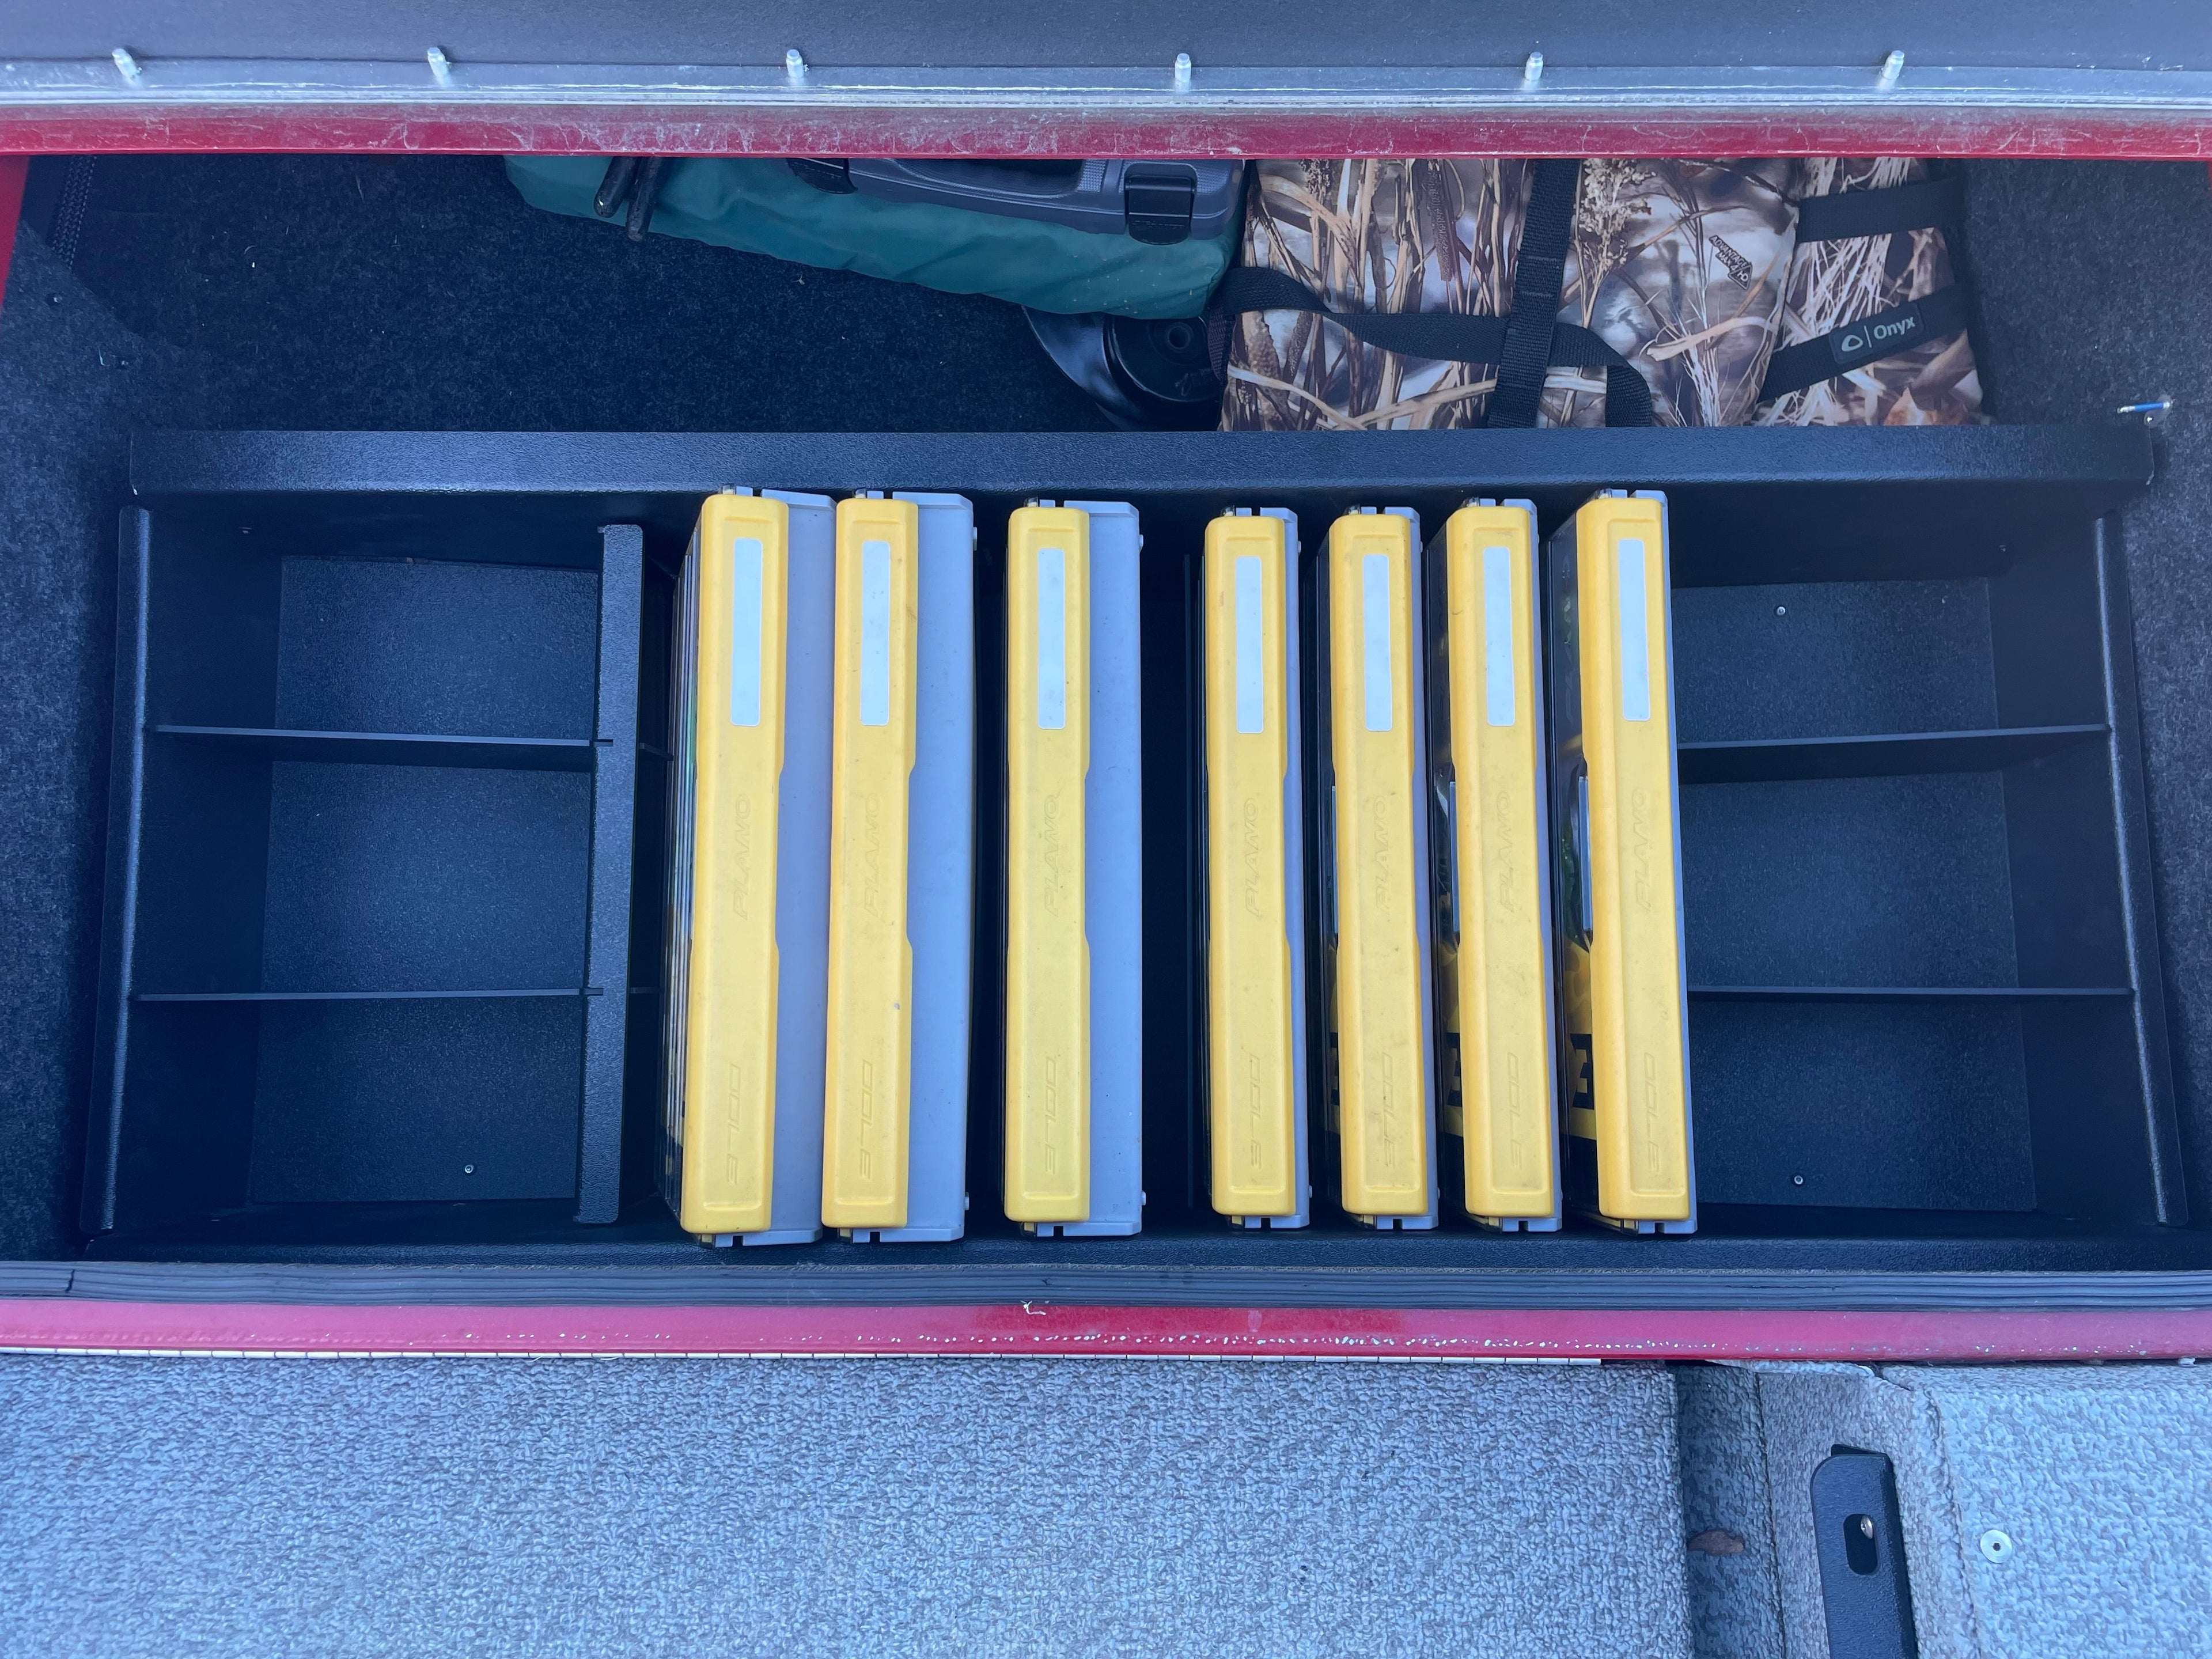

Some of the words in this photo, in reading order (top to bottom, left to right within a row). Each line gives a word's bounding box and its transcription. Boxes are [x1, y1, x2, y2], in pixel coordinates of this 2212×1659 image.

[1710, 235, 1748, 268] ADVANTAGE
[1718, 251, 1732, 267] MAX
[1736, 270, 1749, 282] HD
[1873, 317, 1916, 340] Onyx
[732, 792, 752, 921] PLANO
[863, 792, 881, 918] PLANO
[1044, 793, 1059, 918] PLANO
[1244, 797, 1262, 917] PLANO
[1373, 794, 1391, 916] PLANO
[1495, 790, 1515, 914] PLANO
[1631, 786, 1652, 913] PLANO
[725, 1062, 741, 1186] 3700
[858, 1058, 874, 1180] 3700
[1044, 1056, 1057, 1176] 3700
[1248, 1053, 1263, 1171] 3700
[1381, 1051, 1396, 1168] 3700
[1506, 1051, 1523, 1171] 3700
[1643, 1051, 1661, 1172] 3700
